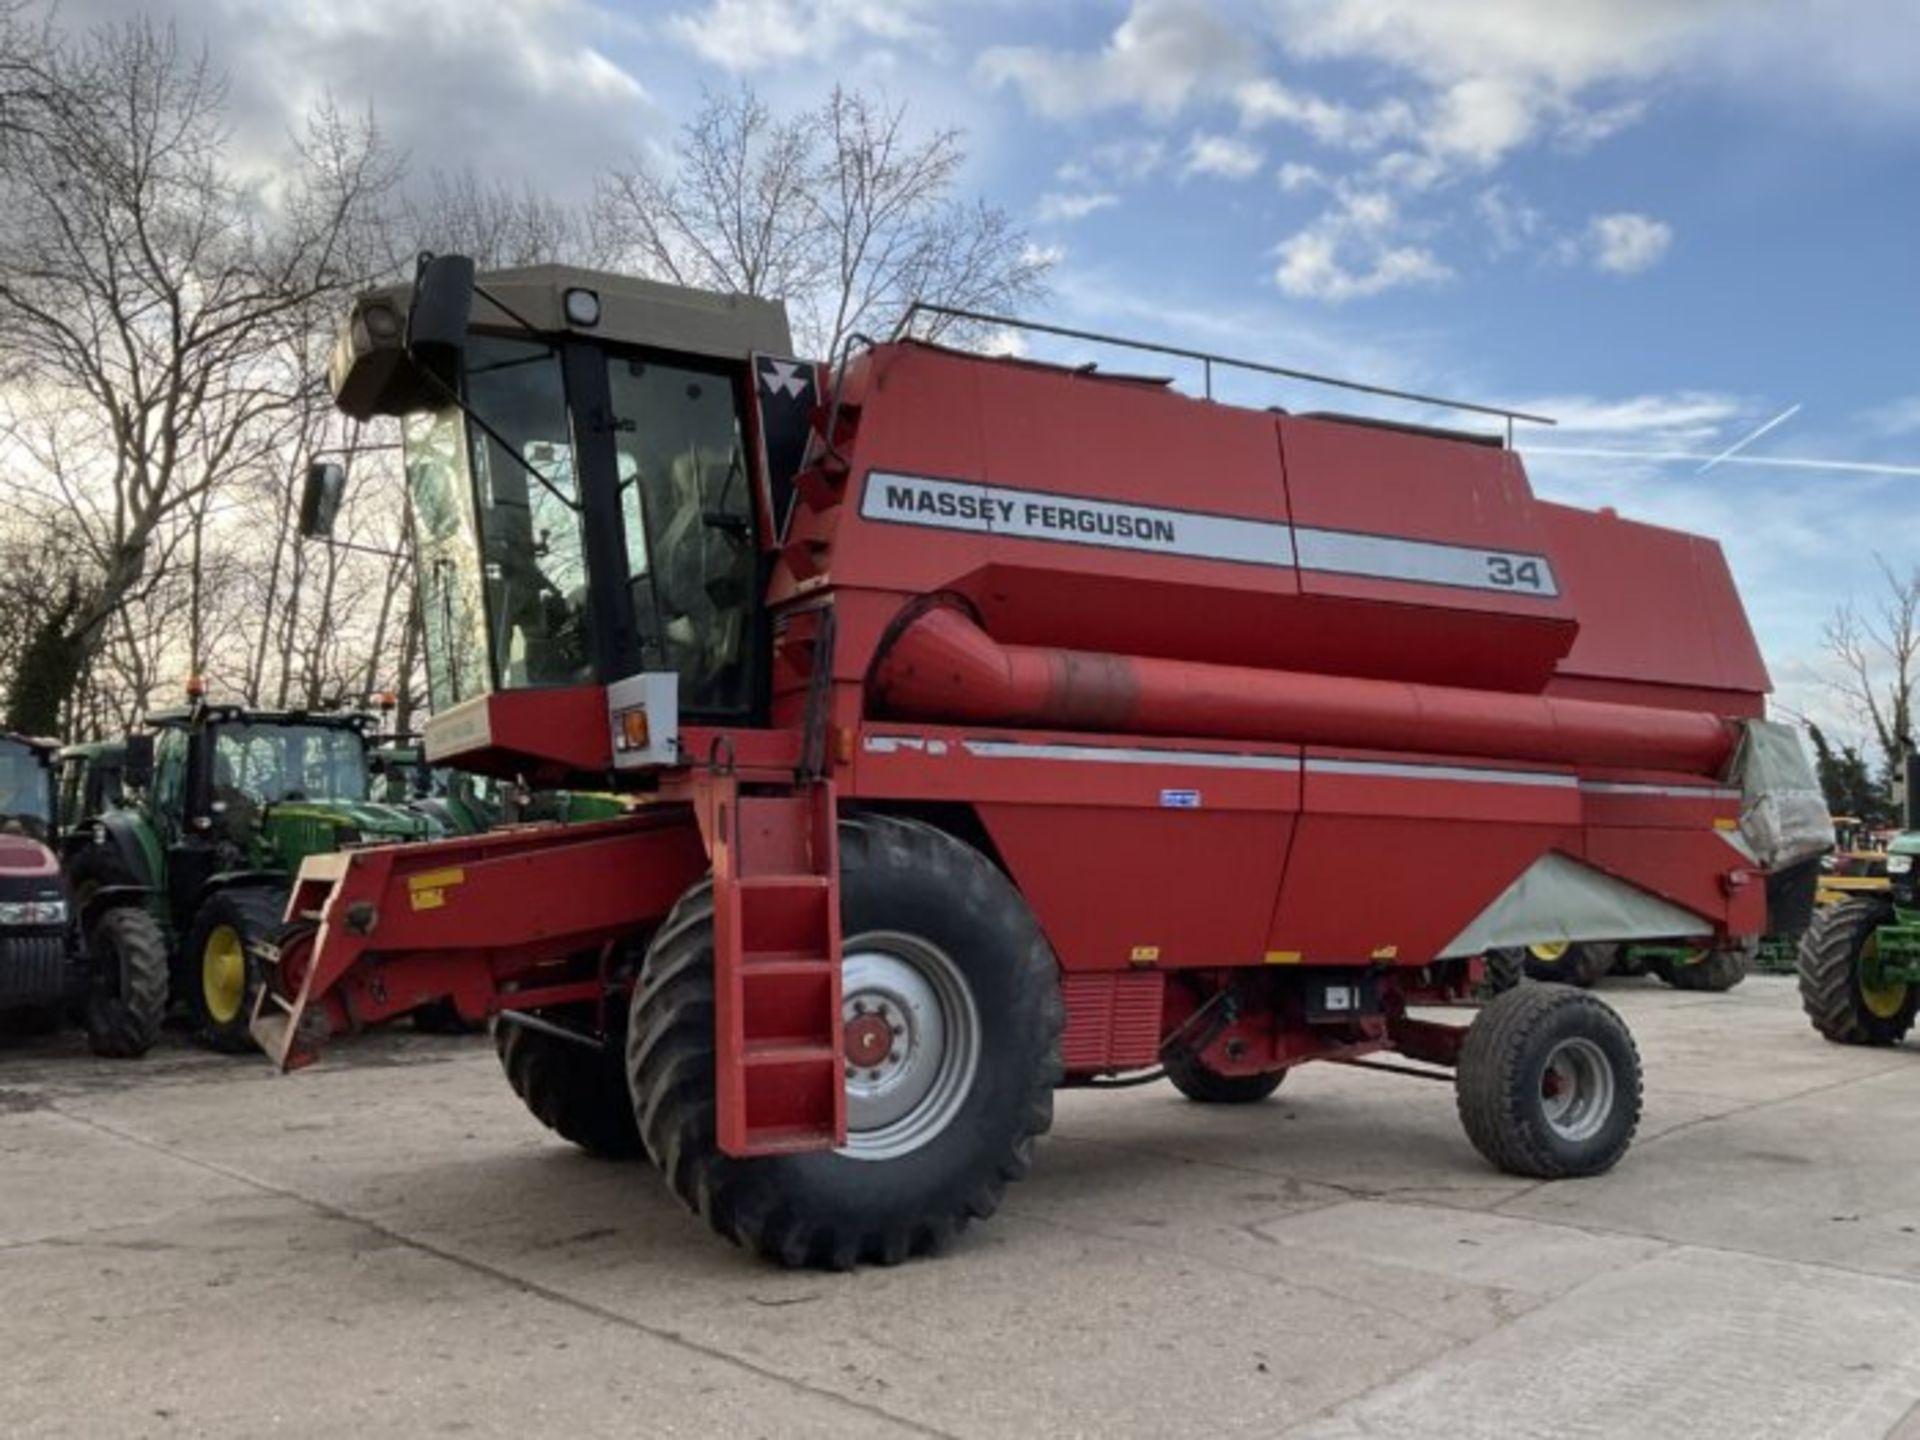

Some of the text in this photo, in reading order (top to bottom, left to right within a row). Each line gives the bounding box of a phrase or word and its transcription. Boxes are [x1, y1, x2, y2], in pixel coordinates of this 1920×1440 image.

[886, 485, 1175, 542] MASSEY FERGUSON
[1486, 556, 1541, 589] 34
